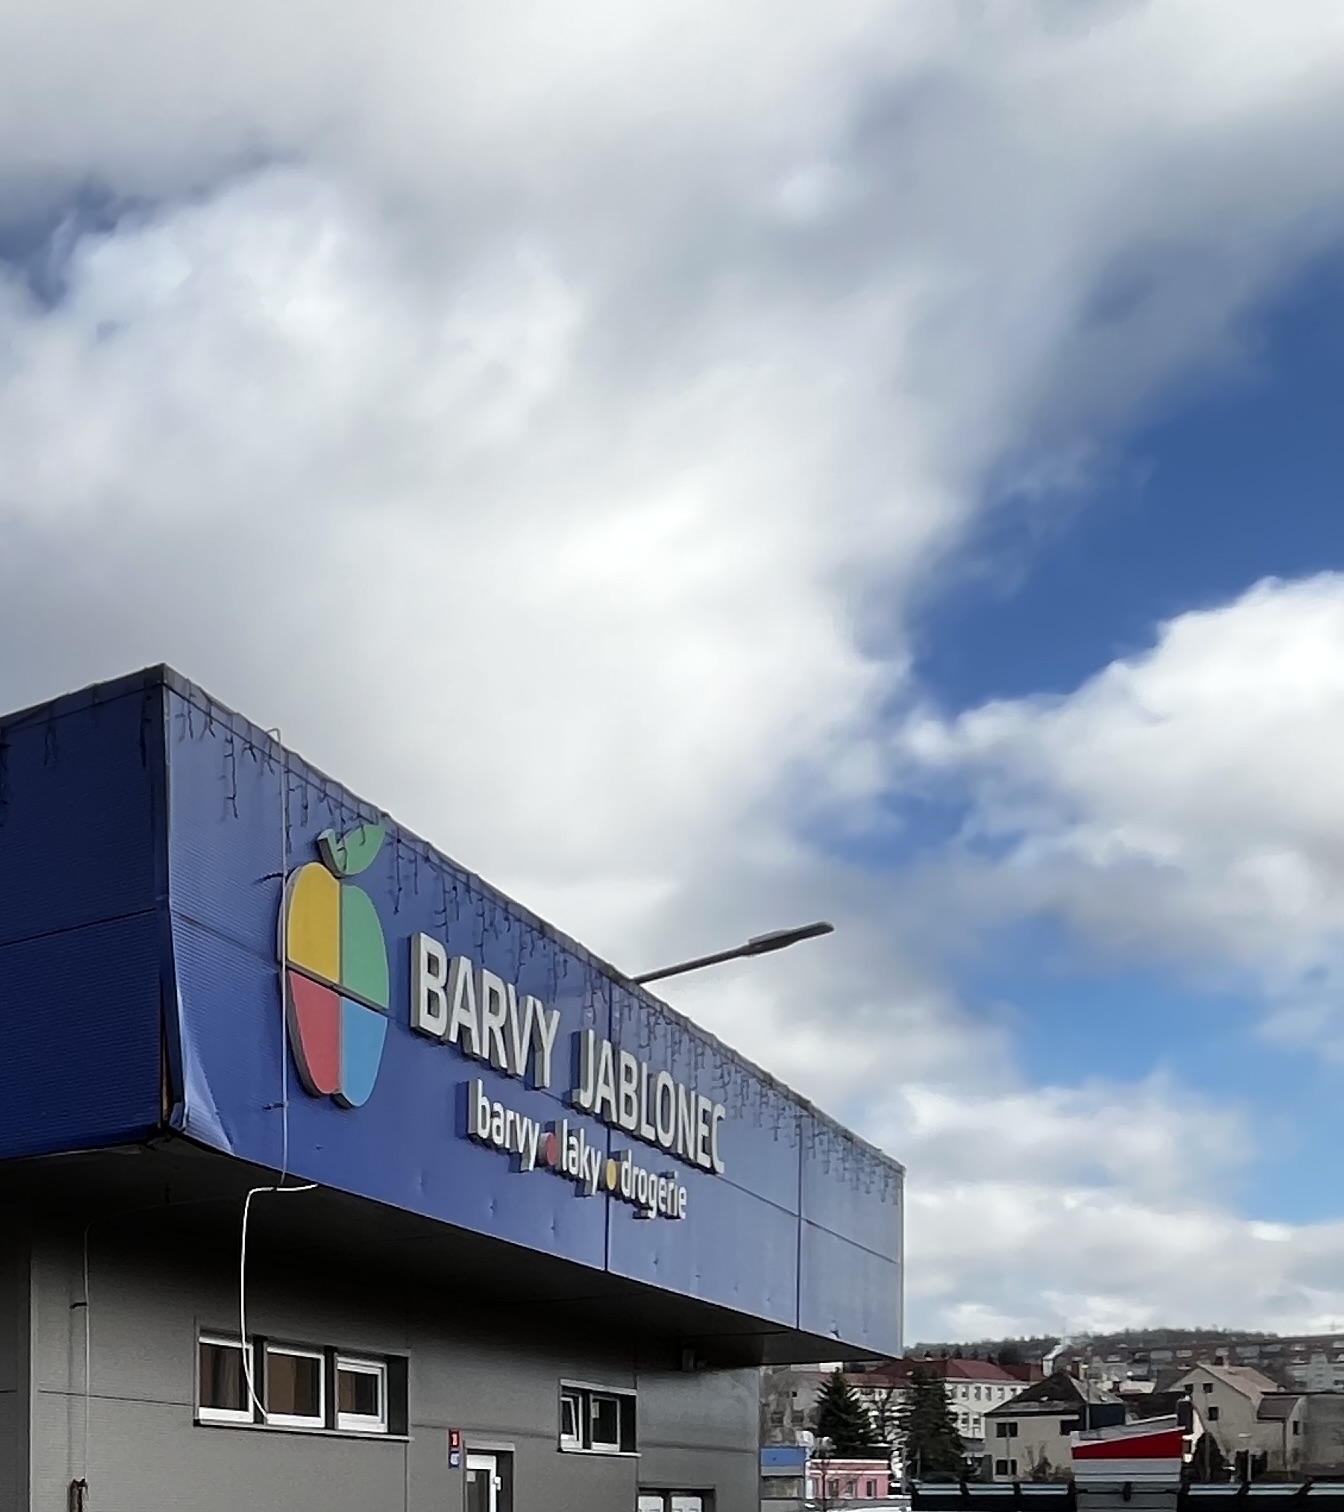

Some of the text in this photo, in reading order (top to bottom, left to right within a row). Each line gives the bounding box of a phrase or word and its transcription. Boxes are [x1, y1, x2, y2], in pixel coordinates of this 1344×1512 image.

[415, 933, 726, 1174] BARVY JABLONEC
[473, 1079, 687, 1219] barvy laky drogerie
